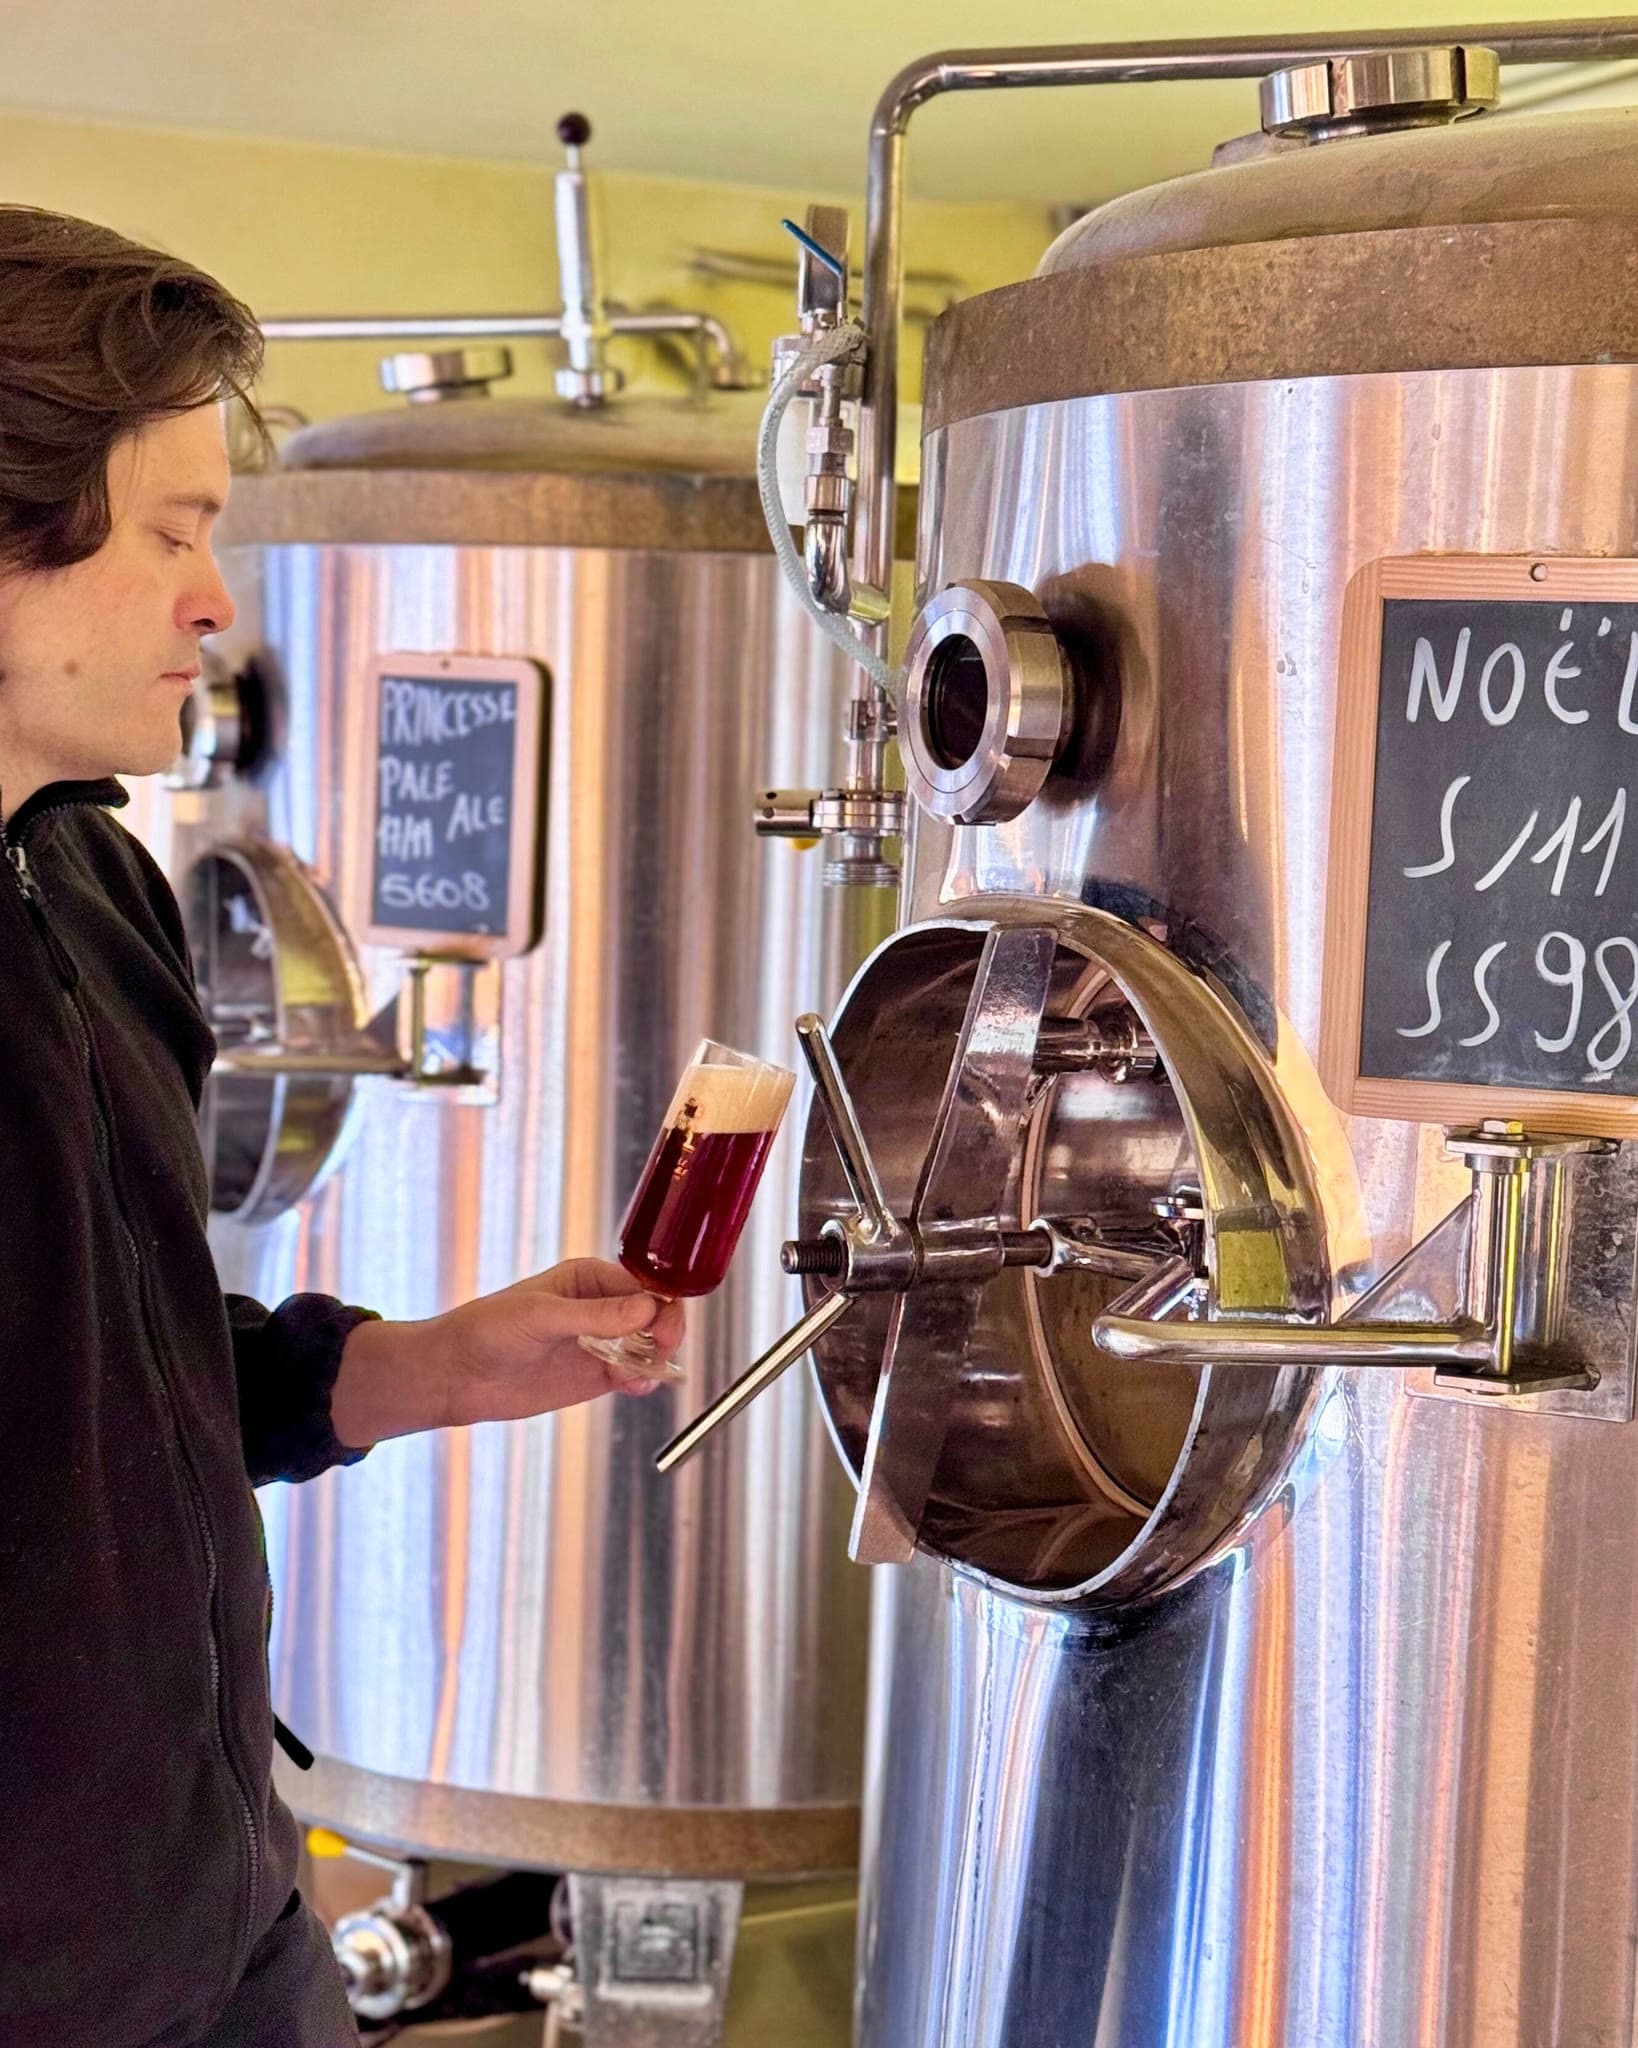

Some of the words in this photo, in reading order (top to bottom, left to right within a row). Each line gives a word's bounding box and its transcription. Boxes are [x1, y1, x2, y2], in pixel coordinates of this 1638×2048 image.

[380, 680, 516, 747] PRINCESSE
[380, 756, 454, 808] PALE
[446, 795, 505, 843] ALE
[381, 869, 490, 912] 5608
